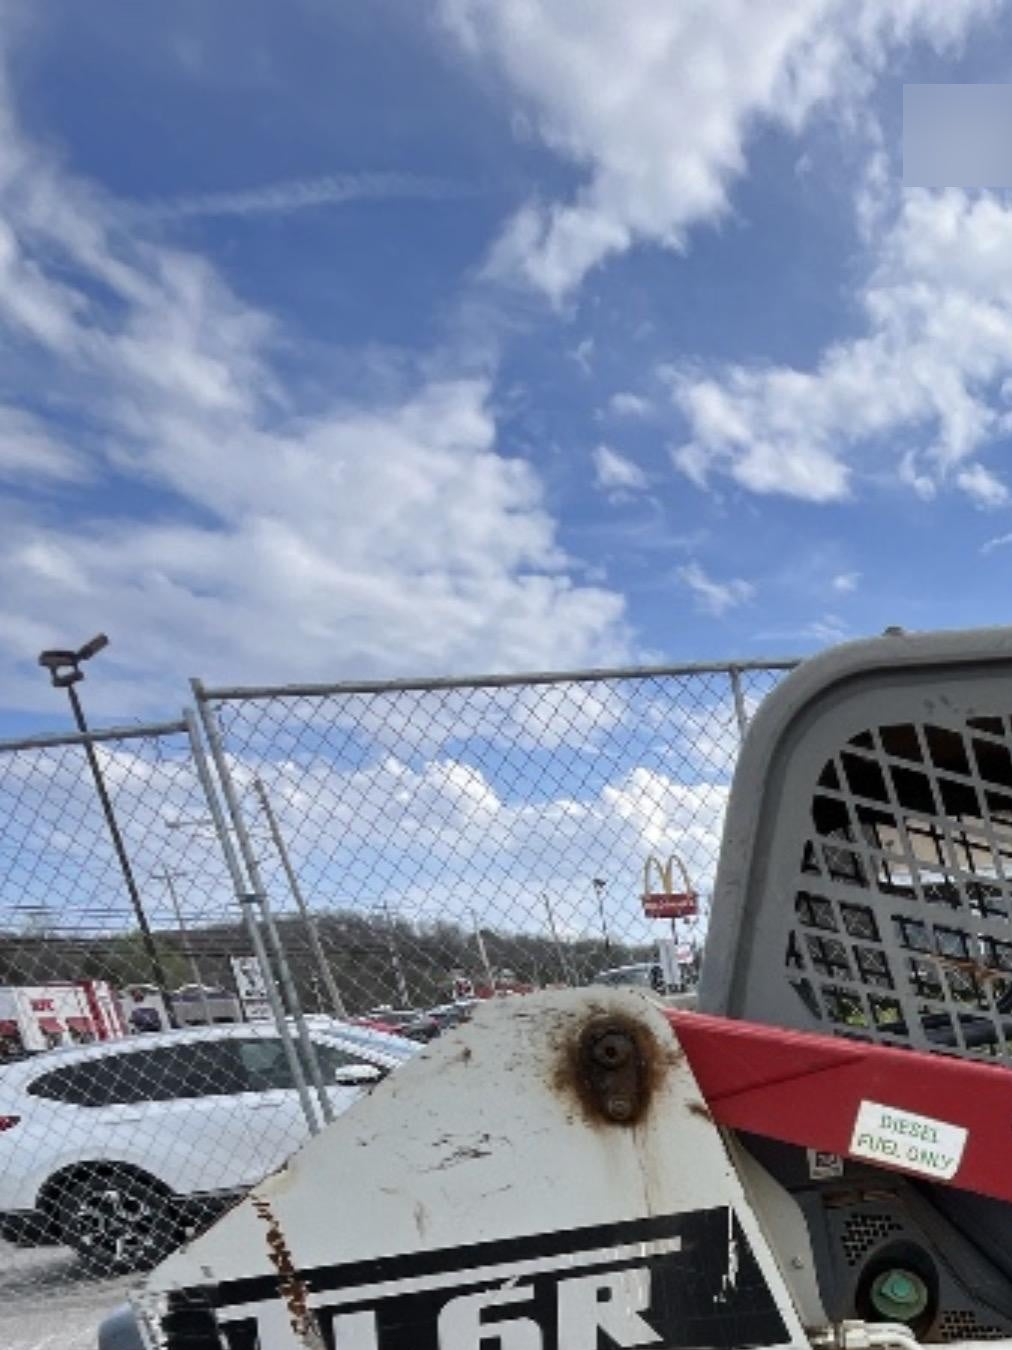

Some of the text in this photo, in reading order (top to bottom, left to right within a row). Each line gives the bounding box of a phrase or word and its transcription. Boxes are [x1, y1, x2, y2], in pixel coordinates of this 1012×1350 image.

[880, 1114, 937, 1144] DIESEL
[857, 1133, 954, 1170] FUEL ONLY
